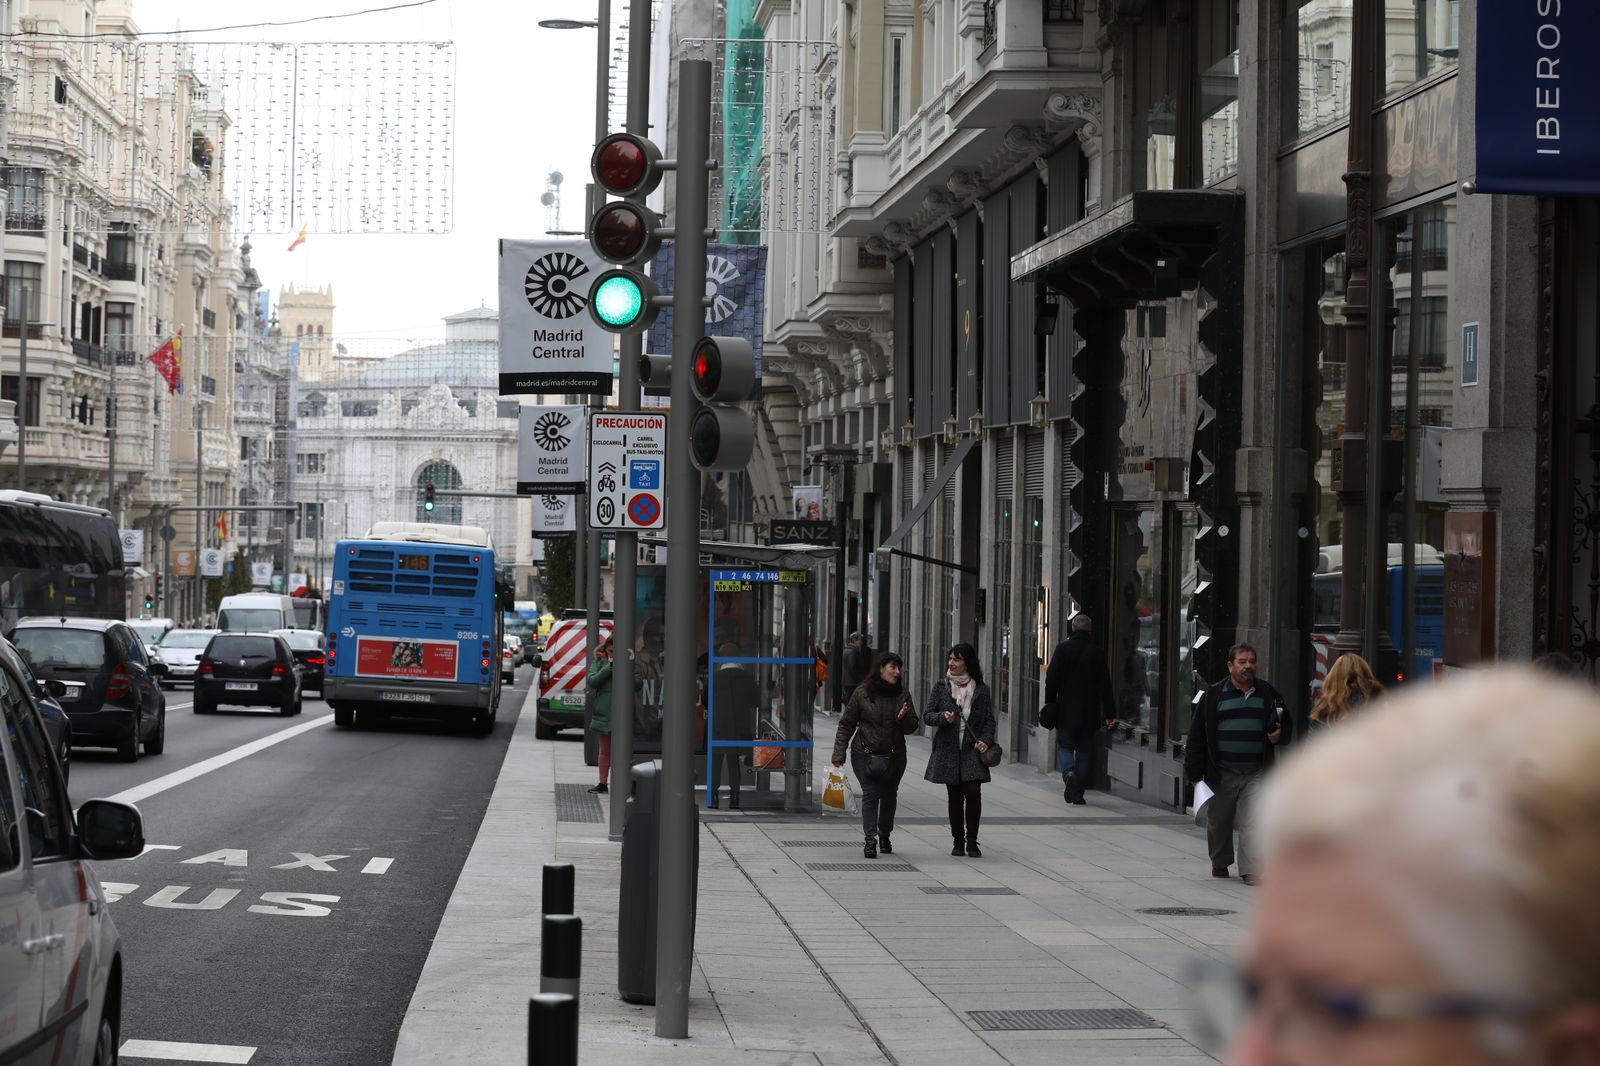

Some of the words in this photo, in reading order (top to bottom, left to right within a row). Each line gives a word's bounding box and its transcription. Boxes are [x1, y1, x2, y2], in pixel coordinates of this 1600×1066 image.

[533, 329, 583, 342] Madrid
[532, 346, 585, 359] Central
[1466, 331, 1475, 362] H
[515, 378, 598, 388] madrid.es/madridcentral
[596, 416, 663, 429] PRECAUCIÓN
[538, 457, 568, 465] Madrid
[537, 466, 569, 475] Central
[600, 503, 612, 518] 30
[773, 526, 829, 540] SANZ
[767, 572, 779, 580] 146
[457, 631, 478, 640] 8206
